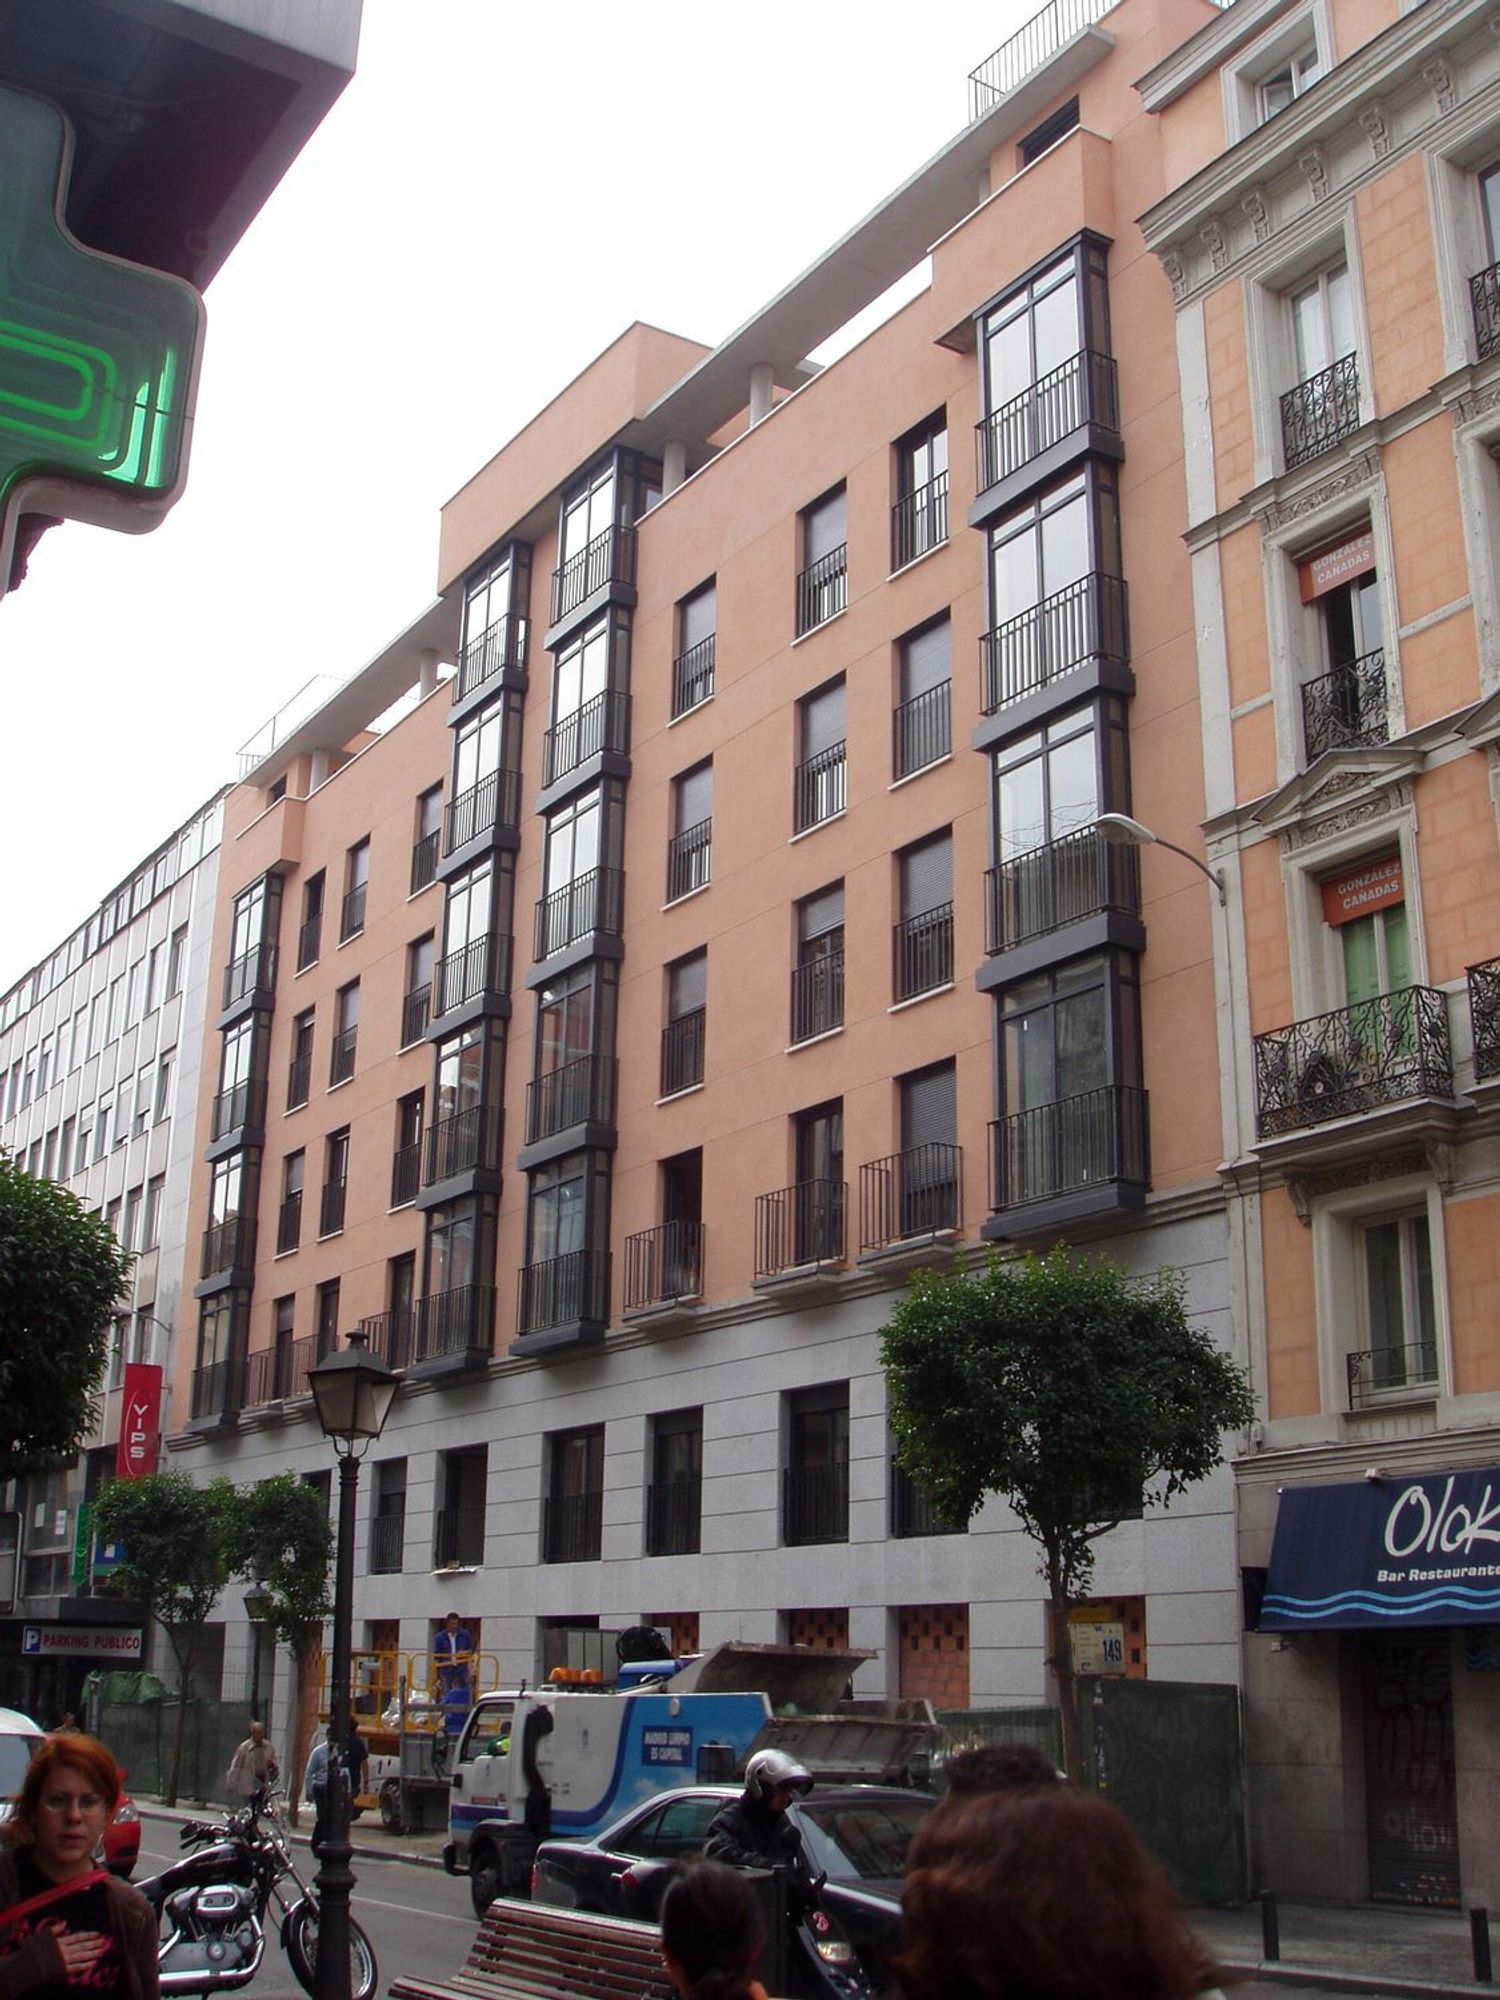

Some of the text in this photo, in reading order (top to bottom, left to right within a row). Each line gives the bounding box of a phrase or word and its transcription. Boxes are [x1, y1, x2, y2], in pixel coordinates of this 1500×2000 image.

[1343, 880, 1399, 910] CAÑADAS
[131, 1404, 149, 1459] VIPS
[1377, 1564, 1500, 1582] Bar Restaurante
[44, 1634, 89, 1649] PARKING
[1103, 1638, 1122, 1662] 149
